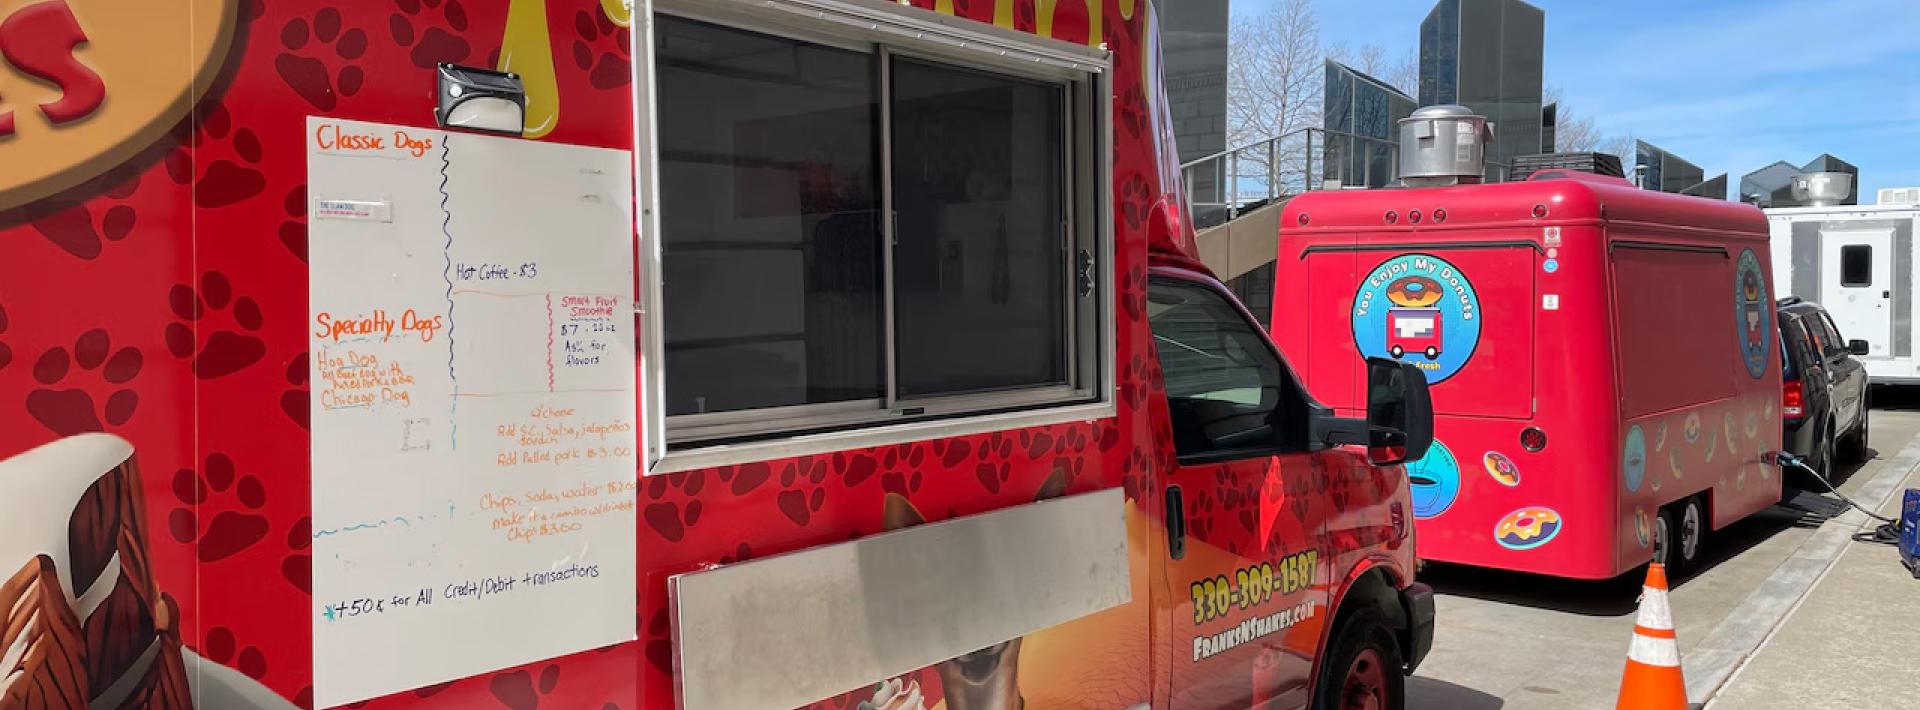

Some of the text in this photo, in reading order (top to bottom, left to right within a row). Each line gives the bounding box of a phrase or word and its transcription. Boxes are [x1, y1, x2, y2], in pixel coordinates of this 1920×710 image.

[316, 123, 433, 158] Classic Dogs
[456, 263, 477, 280] Hot
[479, 262, 509, 280] Coffee
[519, 262, 538, 279] $3
[561, 295, 618, 307] Smart Fruit
[1356, 258, 1473, 320] You Enjoy My Donuts
[316, 308, 442, 343] Specialty Dogs
[570, 307, 613, 317] Smoothie
[381, 387, 410, 408] Dog
[390, 594, 411, 608] for
[416, 588, 433, 606] All
[444, 577, 516, 600] Credit/Debit
[522, 564, 599, 586] transactions
[1191, 550, 1318, 625] 330-309-1587
